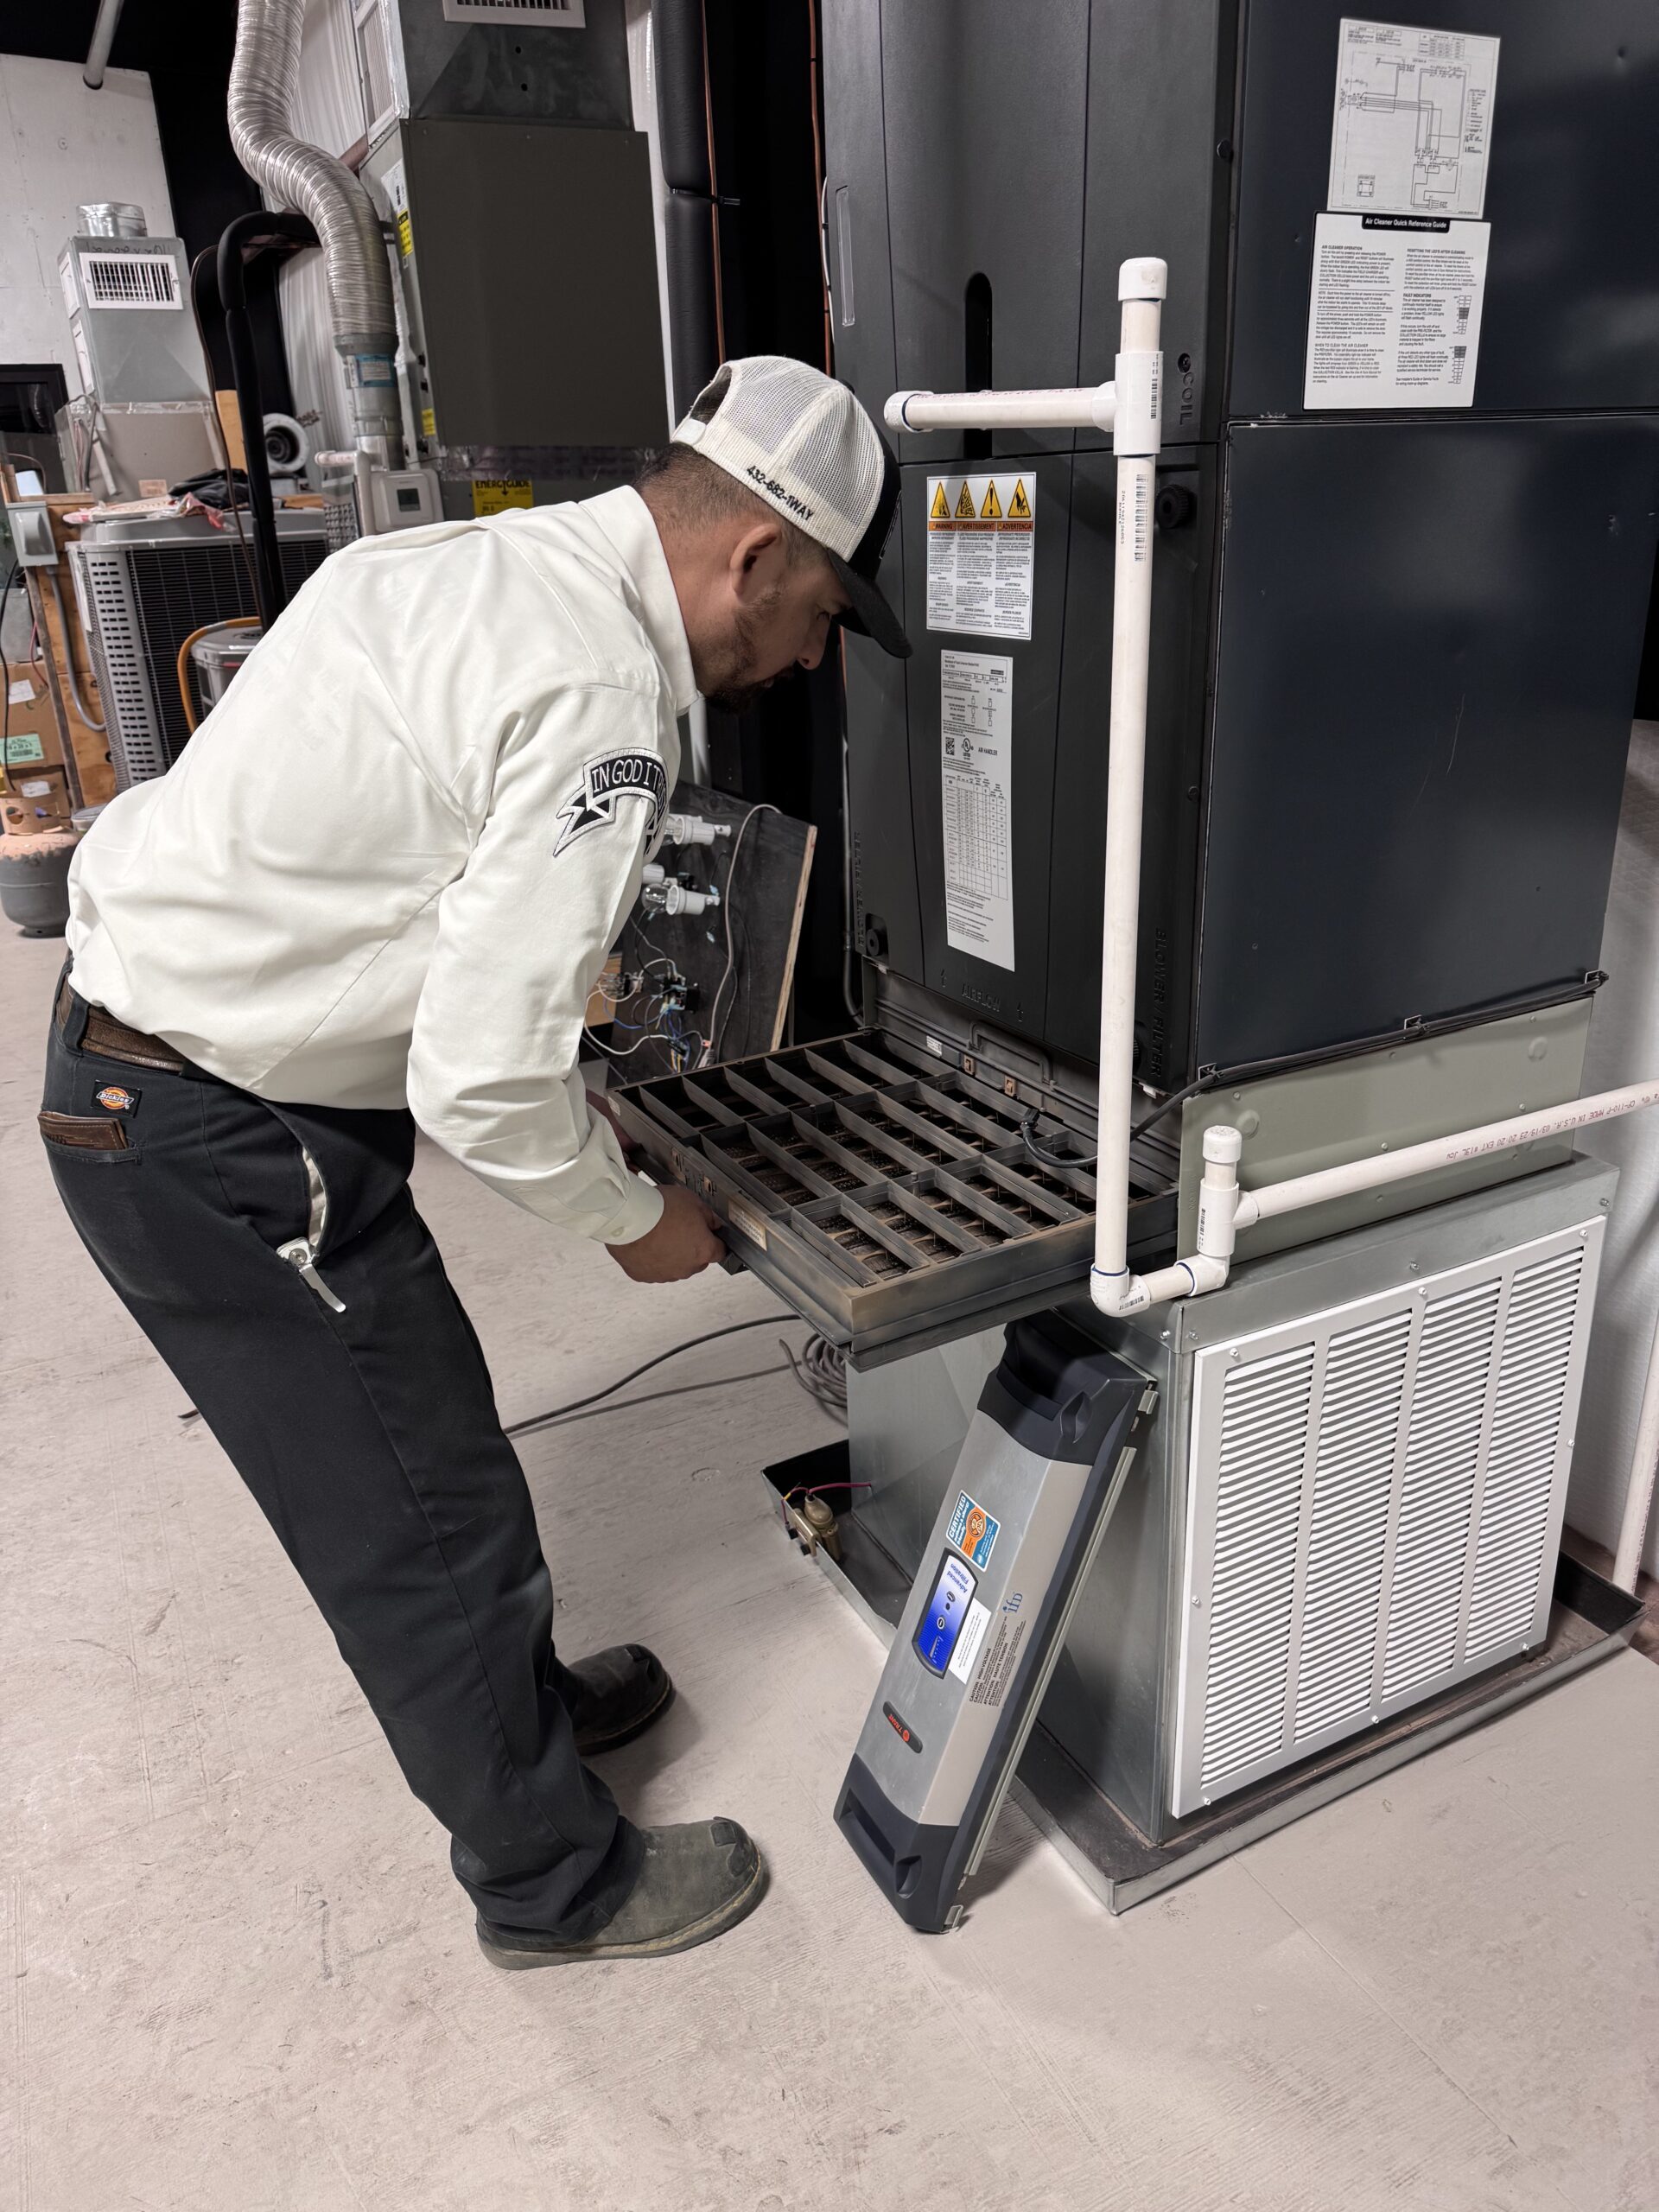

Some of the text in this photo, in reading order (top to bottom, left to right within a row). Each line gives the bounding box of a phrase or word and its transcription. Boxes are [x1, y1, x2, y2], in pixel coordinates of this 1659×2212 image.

[1179, 372, 1195, 426] COIL
[746, 465, 814, 521] 432-682-1WAY
[591, 762, 610, 793] IN
[612, 759, 643, 785] GOD
[643, 762, 651, 786] I
[961, 982, 1001, 1013] AIRFLOW
[1554, 1117, 1576, 1130] U.S.A.
[1579, 1115, 1586, 1123] IN
[1590, 1109, 1604, 1120] MADE
[1482, 1141, 1495, 1153] EXT
[949, 1496, 966, 1538] CERTIFIED
[947, 1571, 968, 1593] Advanced
[950, 1563, 969, 1585] Filtration
[982, 1648, 991, 1669] VOLTAGE
[999, 1643, 1008, 1664] TENSION
